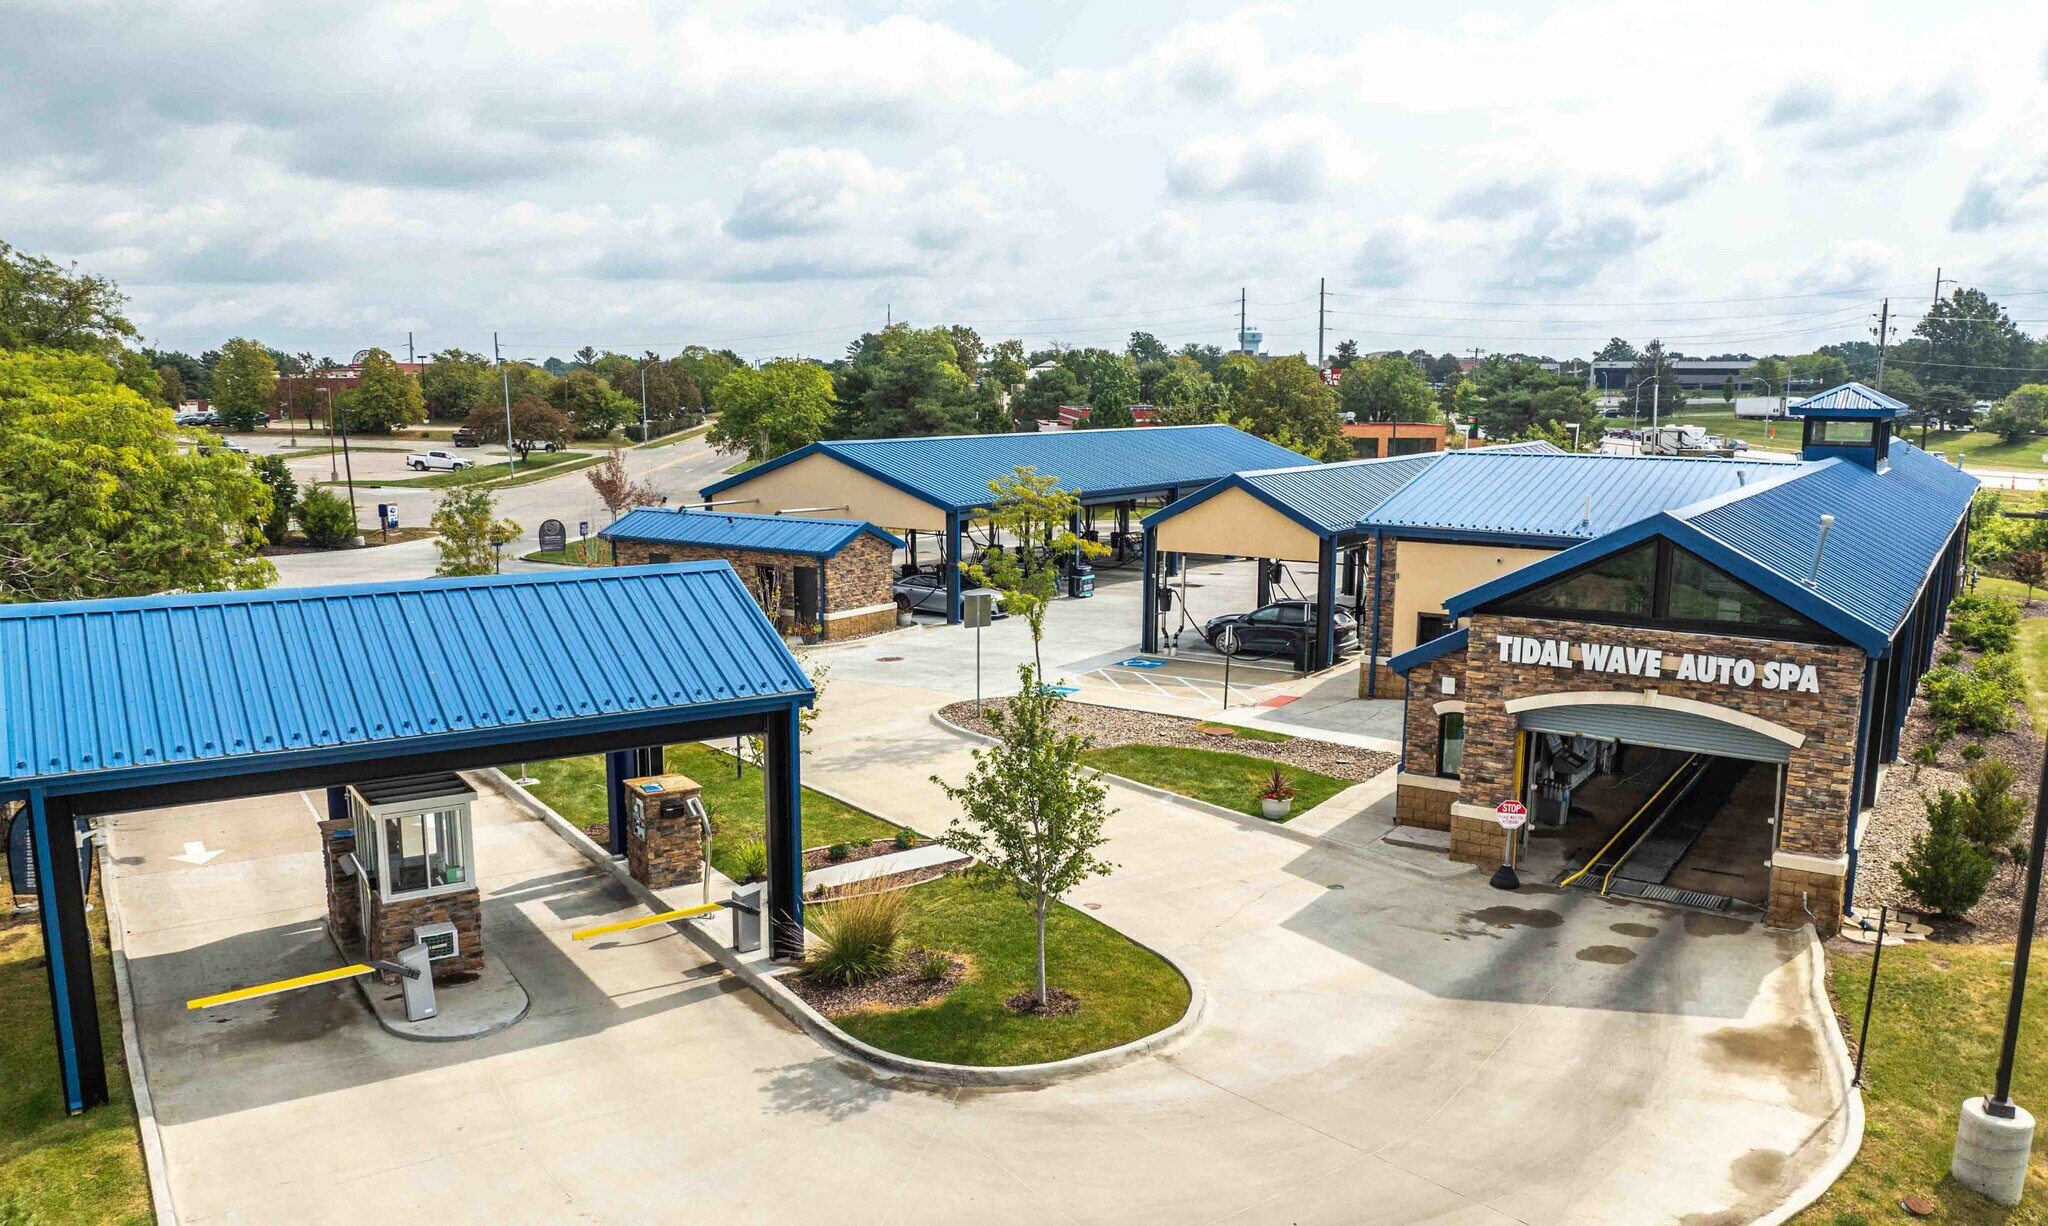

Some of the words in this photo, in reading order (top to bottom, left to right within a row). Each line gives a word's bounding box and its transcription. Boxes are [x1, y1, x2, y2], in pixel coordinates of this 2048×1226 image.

[1496, 635, 1572, 669] TIDAL
[1581, 642, 1662, 678] WAVE
[1676, 653, 1756, 687] AUTO
[1762, 661, 1819, 693] SPA
[1502, 803, 1521, 812] STOP
